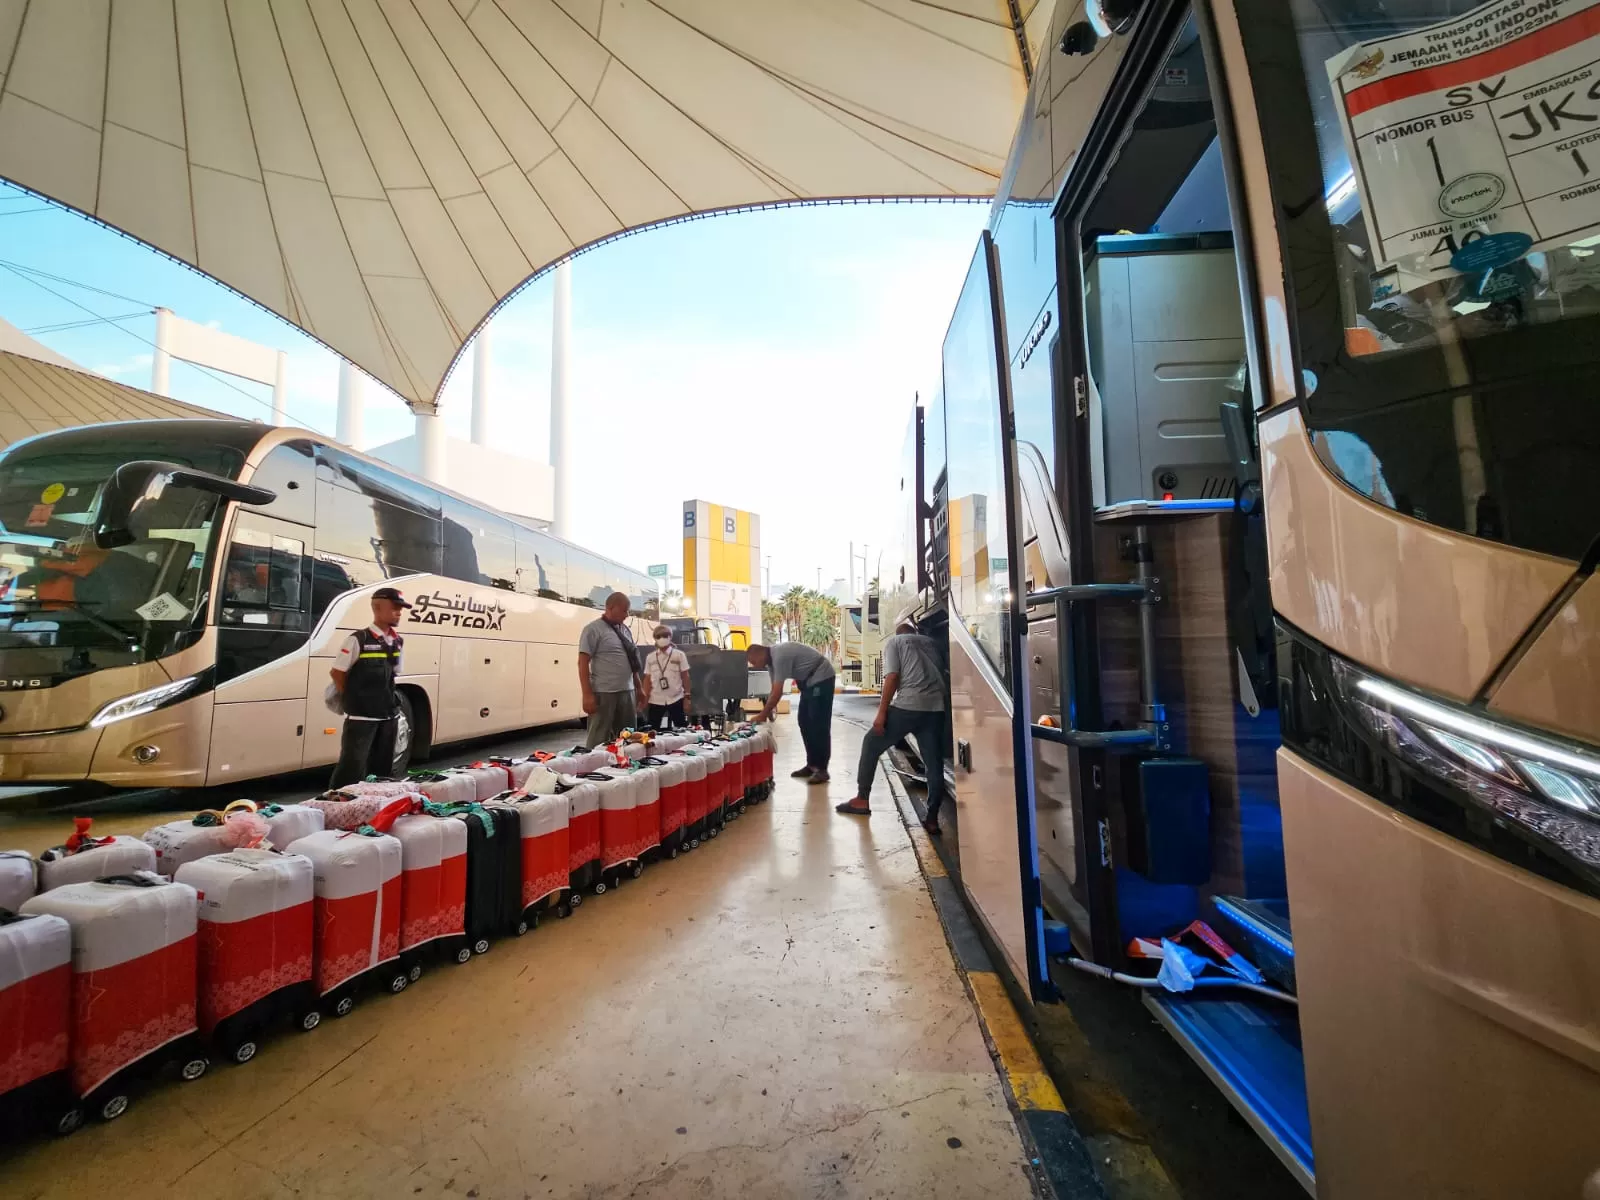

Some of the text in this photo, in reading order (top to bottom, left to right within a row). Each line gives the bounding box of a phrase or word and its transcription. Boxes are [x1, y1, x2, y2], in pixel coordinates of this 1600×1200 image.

[1390, 0, 1569, 63] JEMAAH HAJI INDONE
[1425, 0, 1525, 42] TRANSPORTASI
[1412, 10, 1559, 68] TAHUN 1444H/2023M
[1522, 69, 1593, 101] EMBARKASI
[1374, 109, 1474, 144] NOMOR BUS
[1410, 225, 1453, 242] JUMLAH
[684, 511, 695, 528] B
[725, 517, 735, 533] B
[407, 608, 486, 629] SAPTCO
